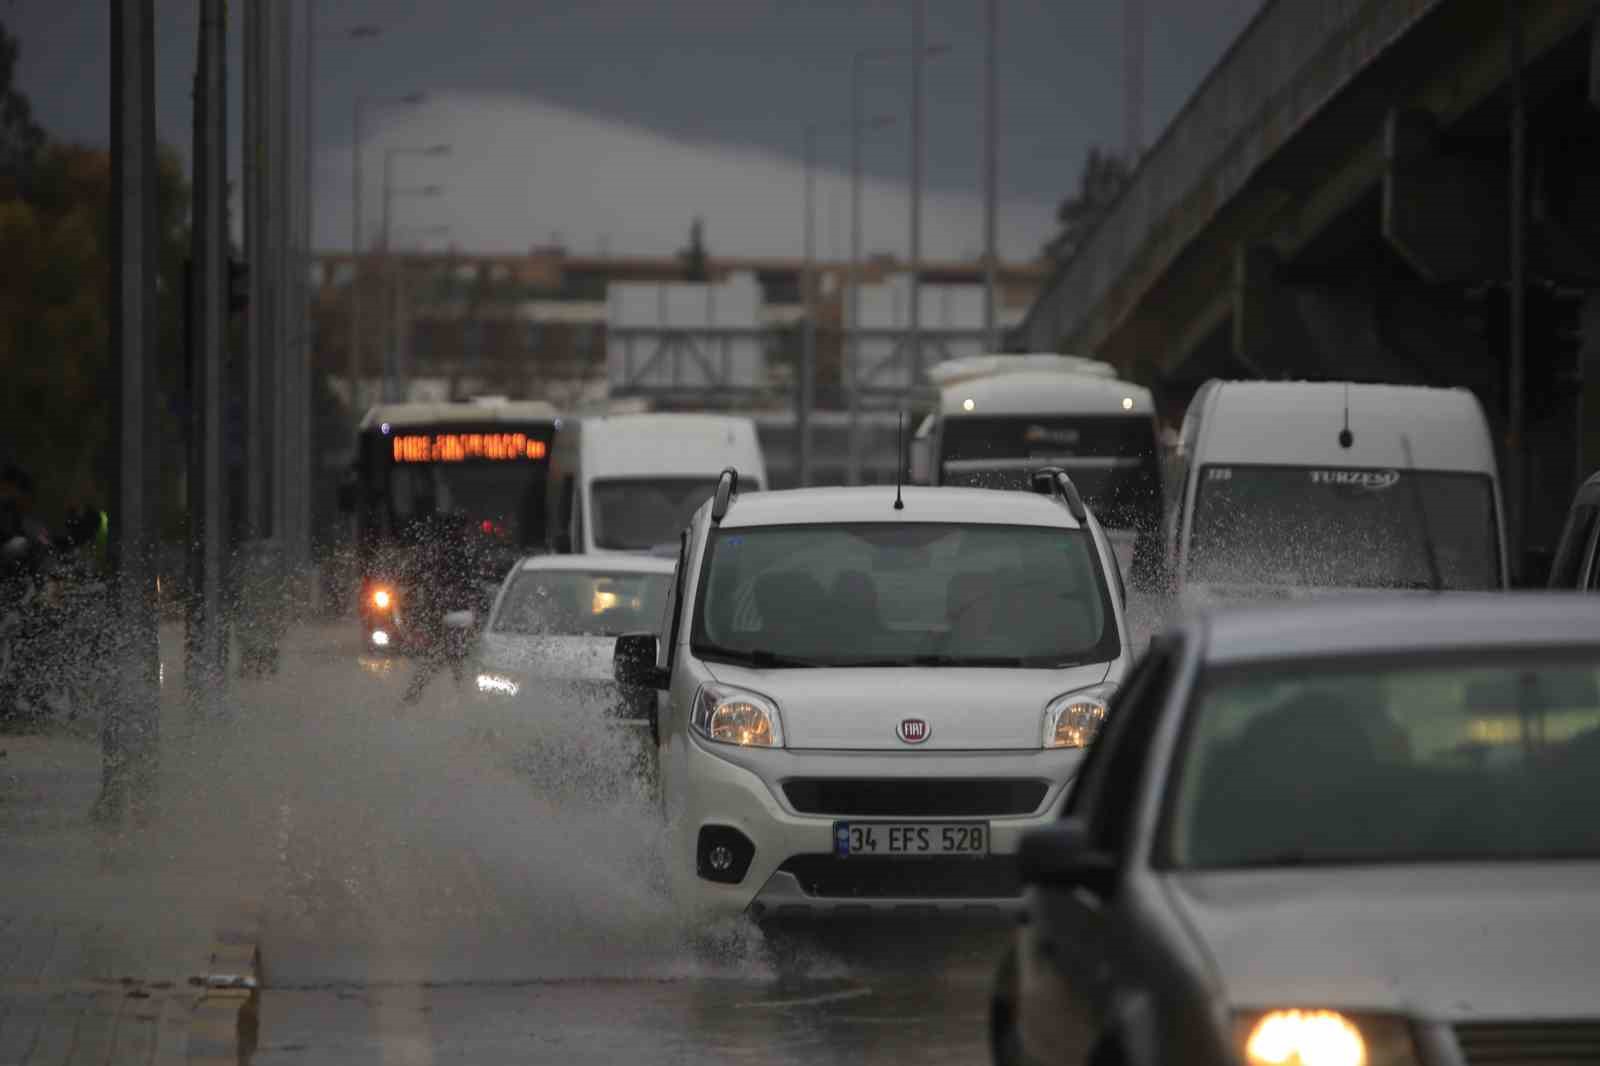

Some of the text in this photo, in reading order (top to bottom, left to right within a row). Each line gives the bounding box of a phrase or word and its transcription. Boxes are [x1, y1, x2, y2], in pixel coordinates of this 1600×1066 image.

[904, 722, 924, 736] FIAT
[850, 827, 983, 851] 34 EFS 528
